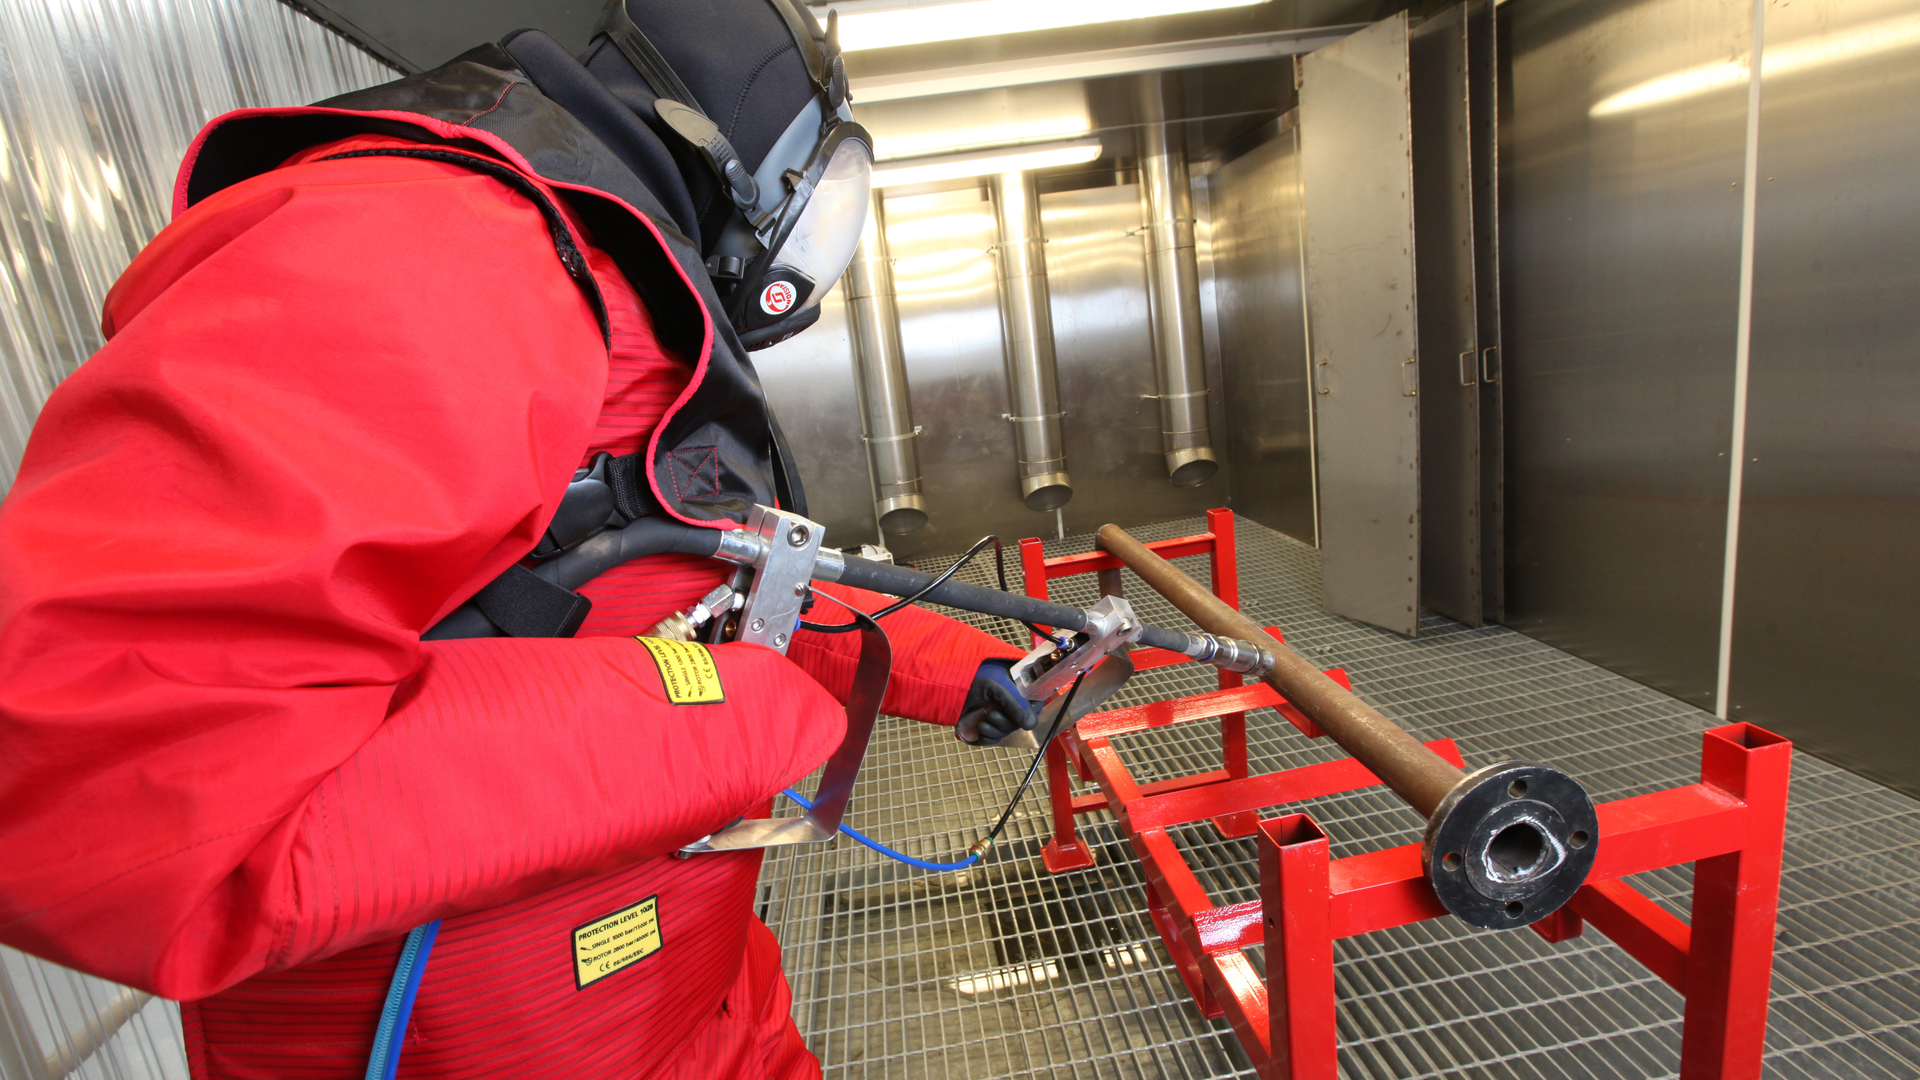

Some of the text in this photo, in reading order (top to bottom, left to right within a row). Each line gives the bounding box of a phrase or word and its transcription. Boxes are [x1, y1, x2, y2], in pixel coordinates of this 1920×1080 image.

[780, 284, 792, 305] VISION
[662, 658, 682, 698] PROTECTION
[578, 920, 619, 941] PROTECTION
[620, 911, 639, 924] LEVEL
[592, 937, 610, 950] SINGLE
[612, 932, 624, 941] 1000
[592, 950, 612, 962] ROTOR
